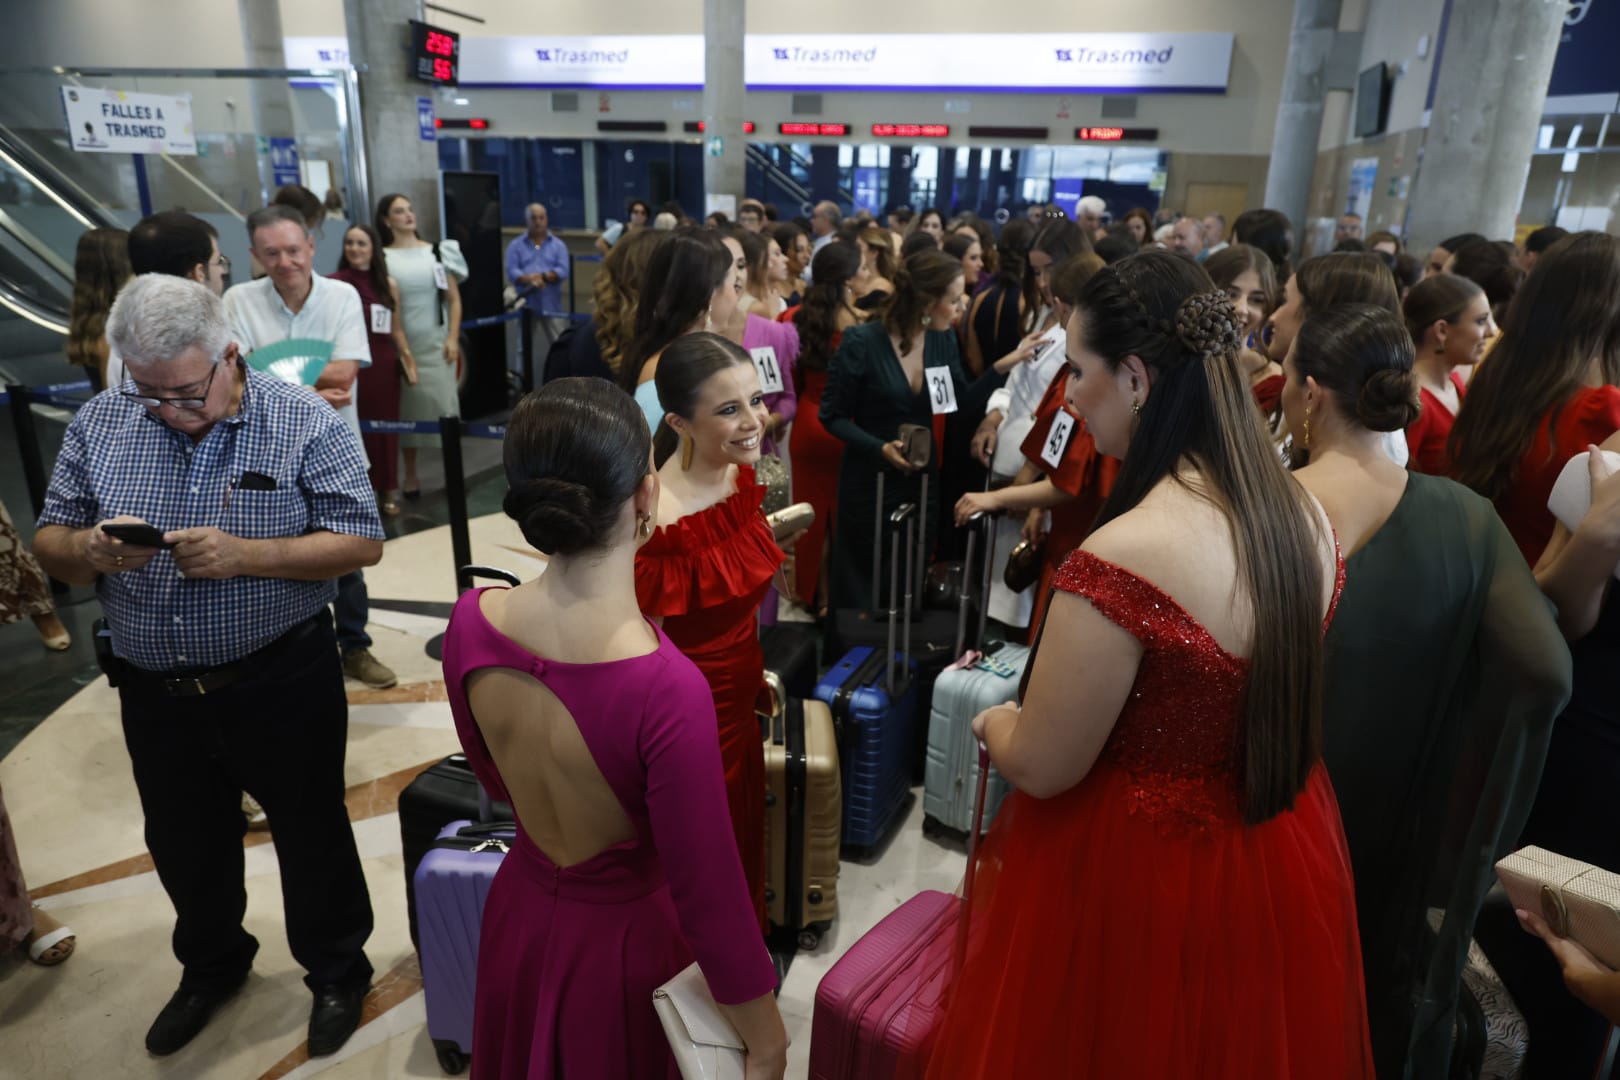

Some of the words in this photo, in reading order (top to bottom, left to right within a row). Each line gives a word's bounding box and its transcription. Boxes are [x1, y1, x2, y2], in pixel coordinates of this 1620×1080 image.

[554, 47, 629, 63] Trasmed
[793, 46, 877, 62] Trasmed
[1078, 45, 1174, 64] Trasmed
[101, 102, 152, 120] FALLES
[155, 106, 165, 121] A
[105, 122, 167, 139] TRASMED
[758, 354, 777, 385] 14
[932, 375, 950, 405] 31
[1048, 421, 1067, 456] 45
